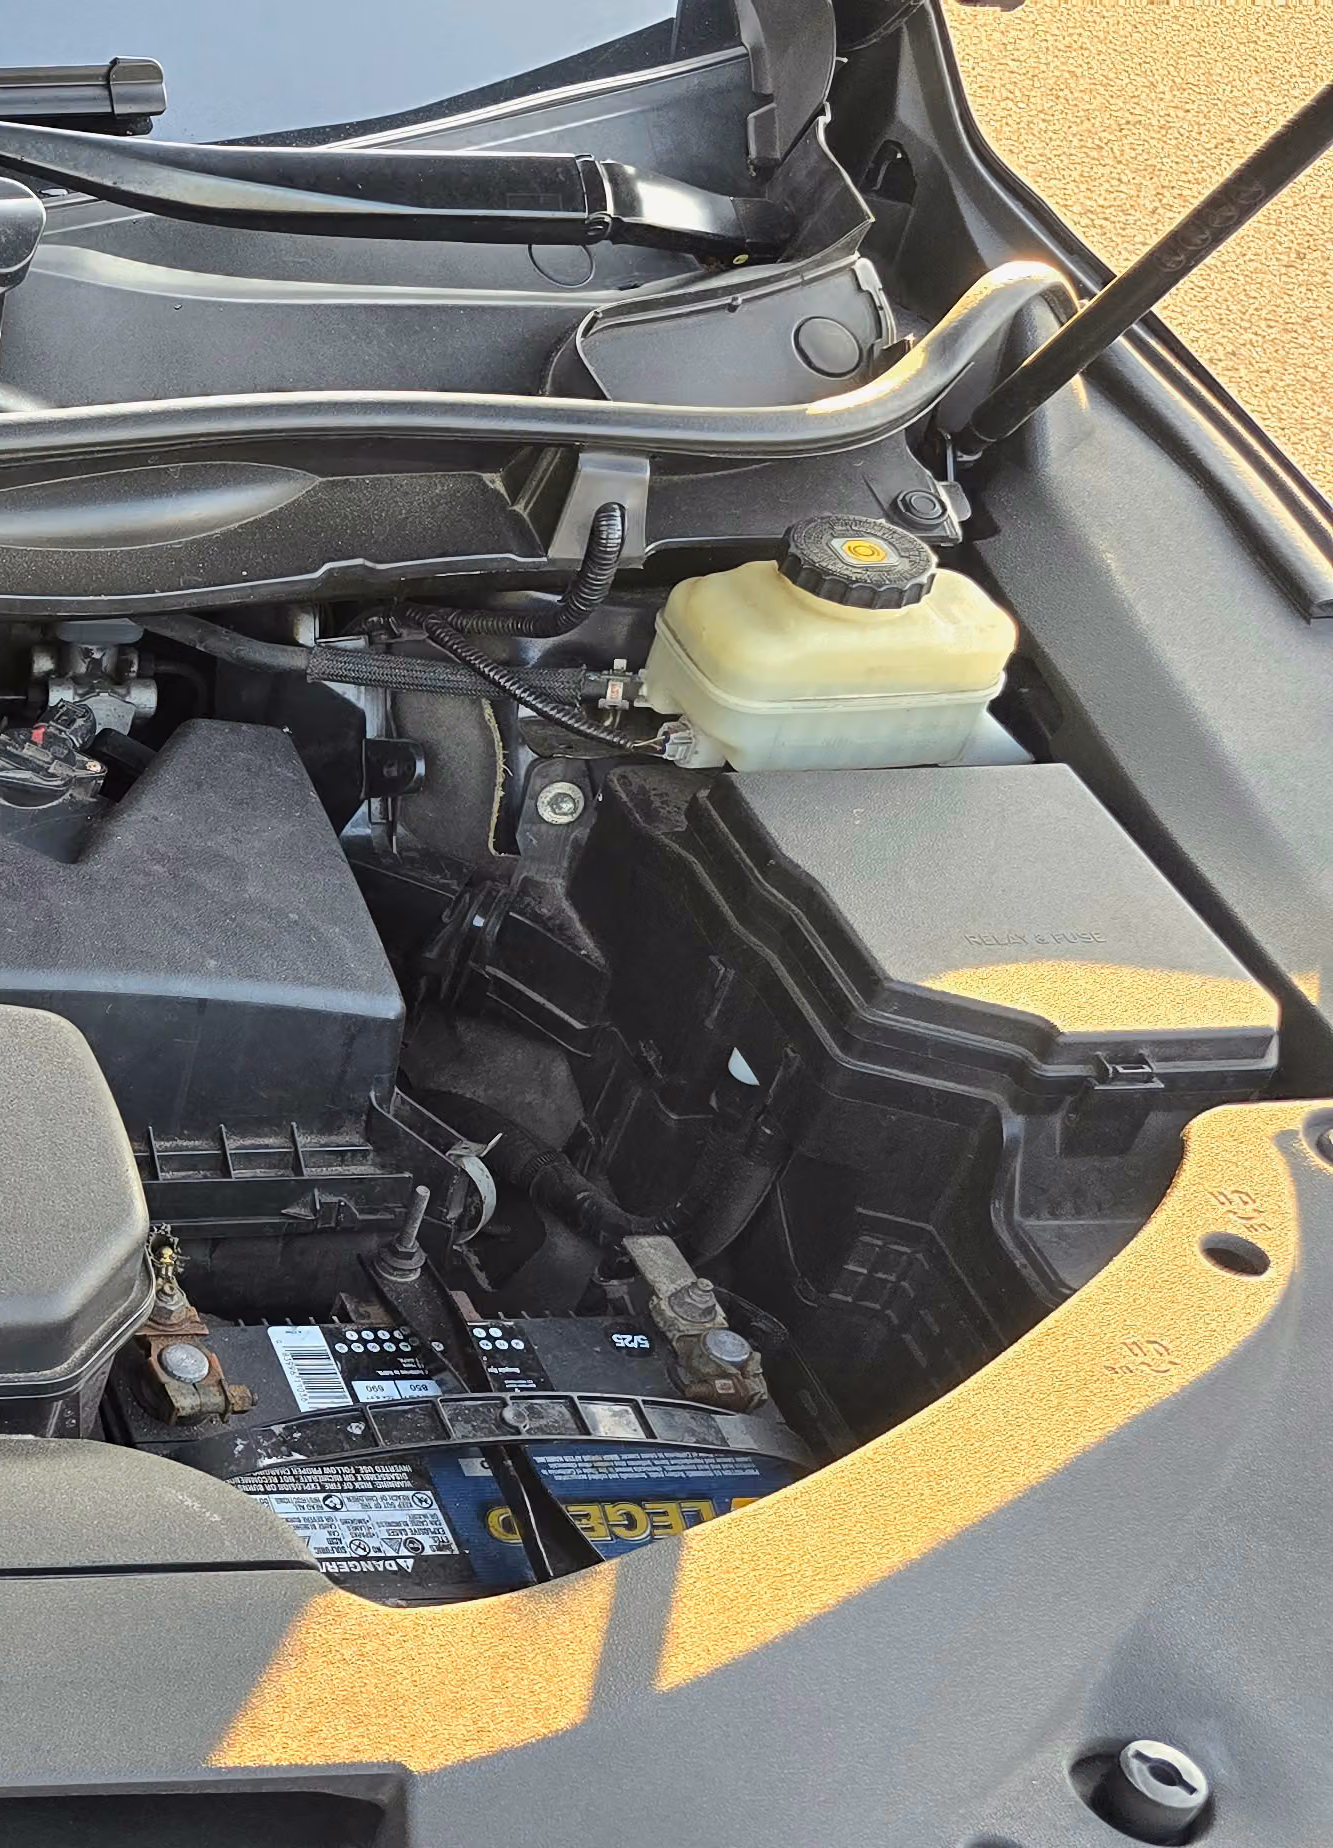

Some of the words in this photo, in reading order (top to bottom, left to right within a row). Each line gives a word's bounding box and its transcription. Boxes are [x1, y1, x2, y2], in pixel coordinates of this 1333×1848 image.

[964, 934, 1028, 946] RELAY
[1035, 934, 1049, 945] &
[1051, 931, 1106, 944] FUSE
[612, 1334, 650, 1348] 5/25
[410, 1384, 429, 1392] 850
[279, 1475, 294, 1483] NOT
[486, 1500, 715, 1545] LEGED
[409, 1527, 445, 1535] EXPLOSIVE
[314, 1546, 346, 1554] SULFURIC
